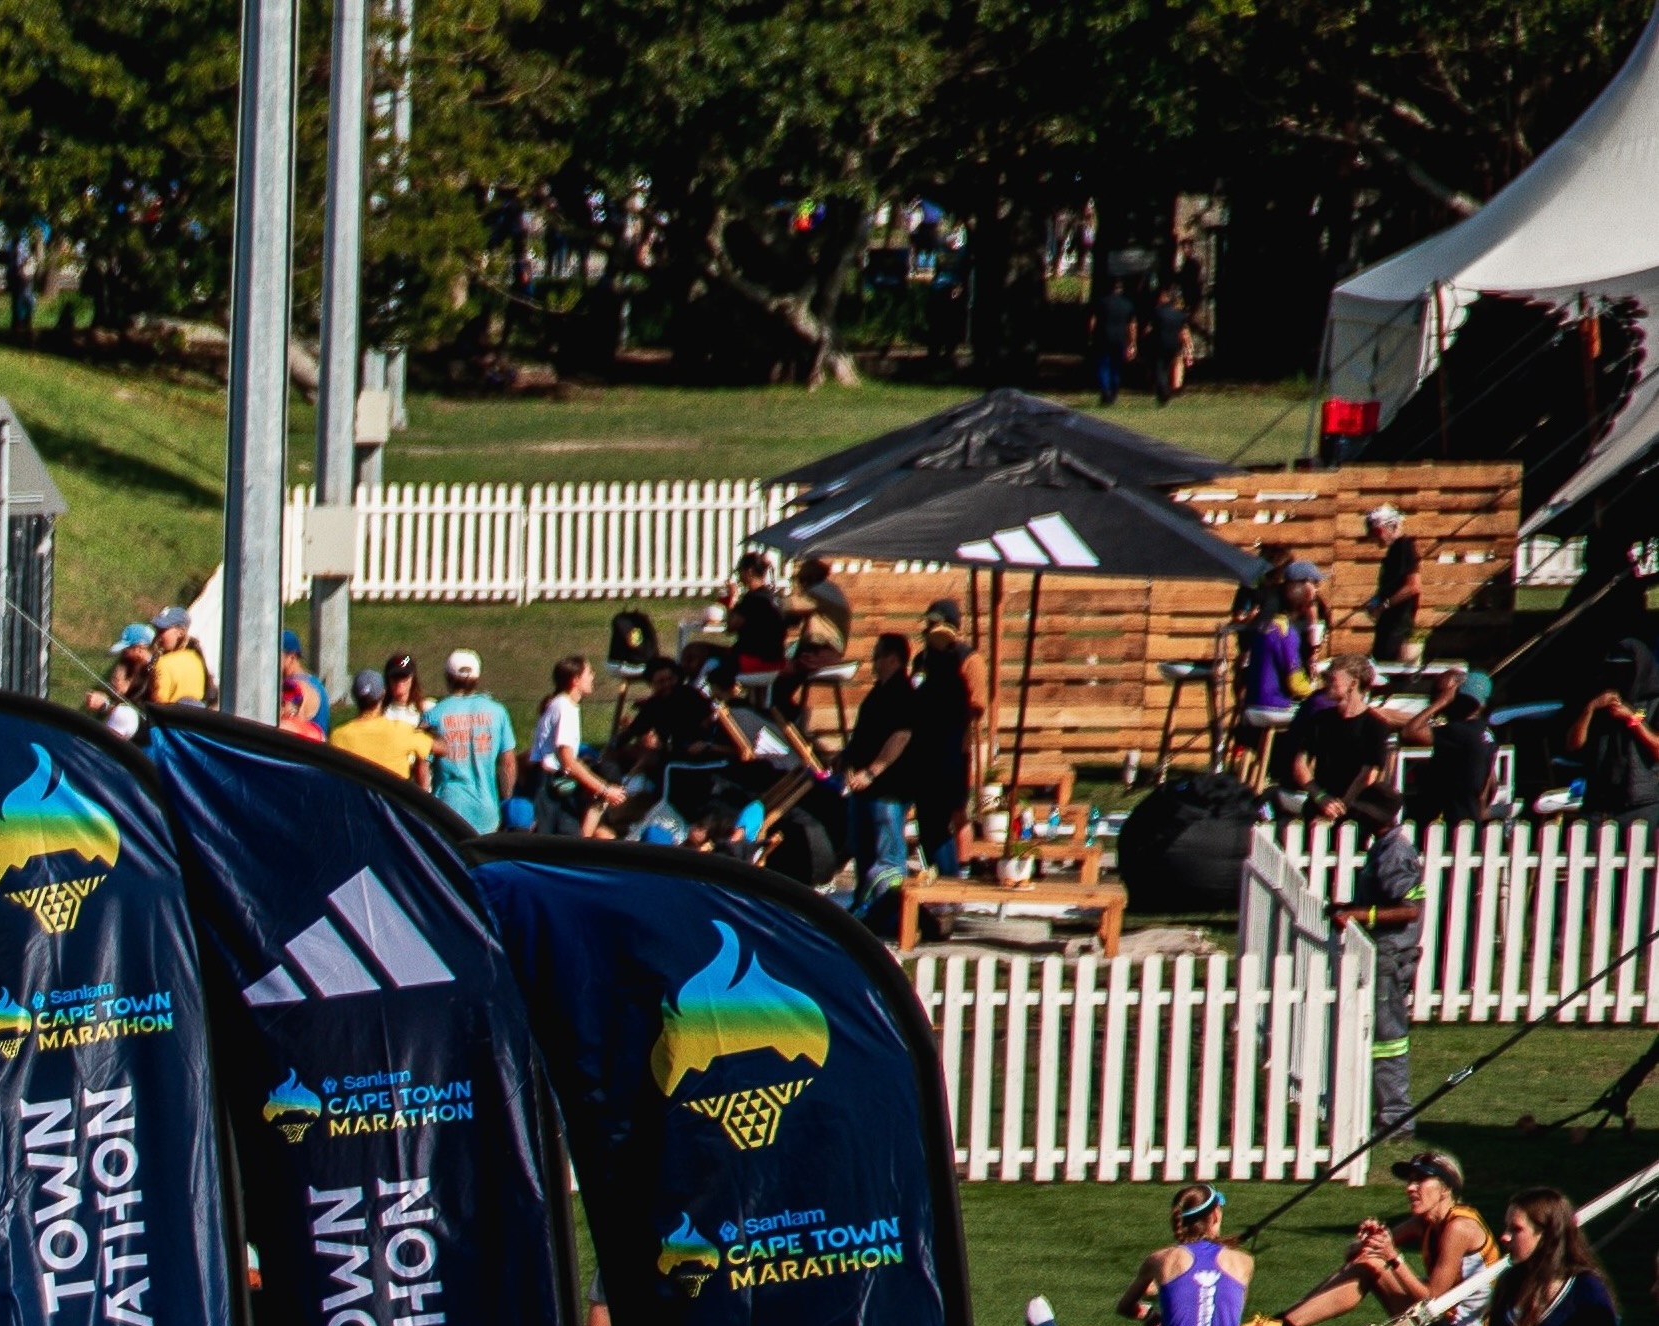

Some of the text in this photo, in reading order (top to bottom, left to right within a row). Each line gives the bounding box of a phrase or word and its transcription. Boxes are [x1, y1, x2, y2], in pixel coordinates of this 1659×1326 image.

[36, 991, 172, 1030] CAPE TOWN
[50, 982, 114, 1004] Sanlam
[37, 1011, 174, 1051] MARATHON
[329, 1080, 473, 1115] CAPE TOWN
[343, 1070, 411, 1090] Sanlam
[330, 1101, 474, 1137] MARATHON
[21, 1097, 92, 1319] TOWN
[745, 1208, 826, 1235] Sanlam
[727, 1217, 900, 1265] CAPE TOWN
[730, 1243, 903, 1291] MARATHON
